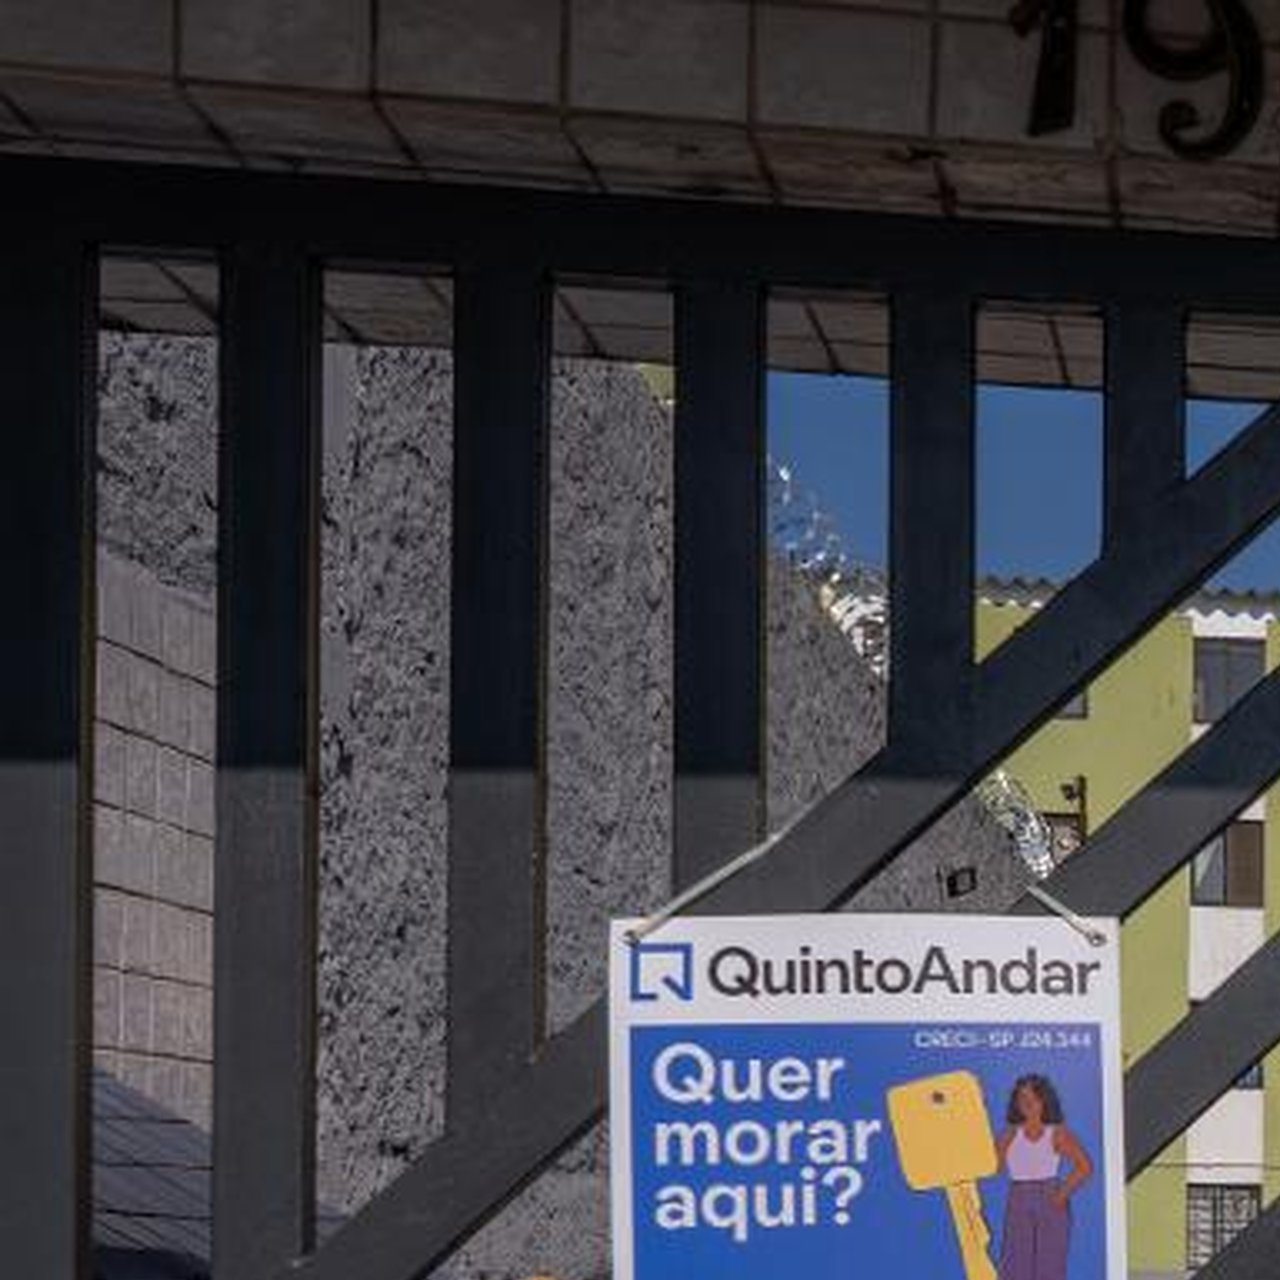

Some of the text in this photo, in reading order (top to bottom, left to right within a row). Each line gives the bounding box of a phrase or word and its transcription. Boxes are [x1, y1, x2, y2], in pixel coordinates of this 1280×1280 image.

[707, 946, 1100, 997] QuintoAndar
[653, 1042, 844, 1103] Quer
[654, 1119, 882, 1166] morar
[655, 1166, 862, 1241] aqui?
